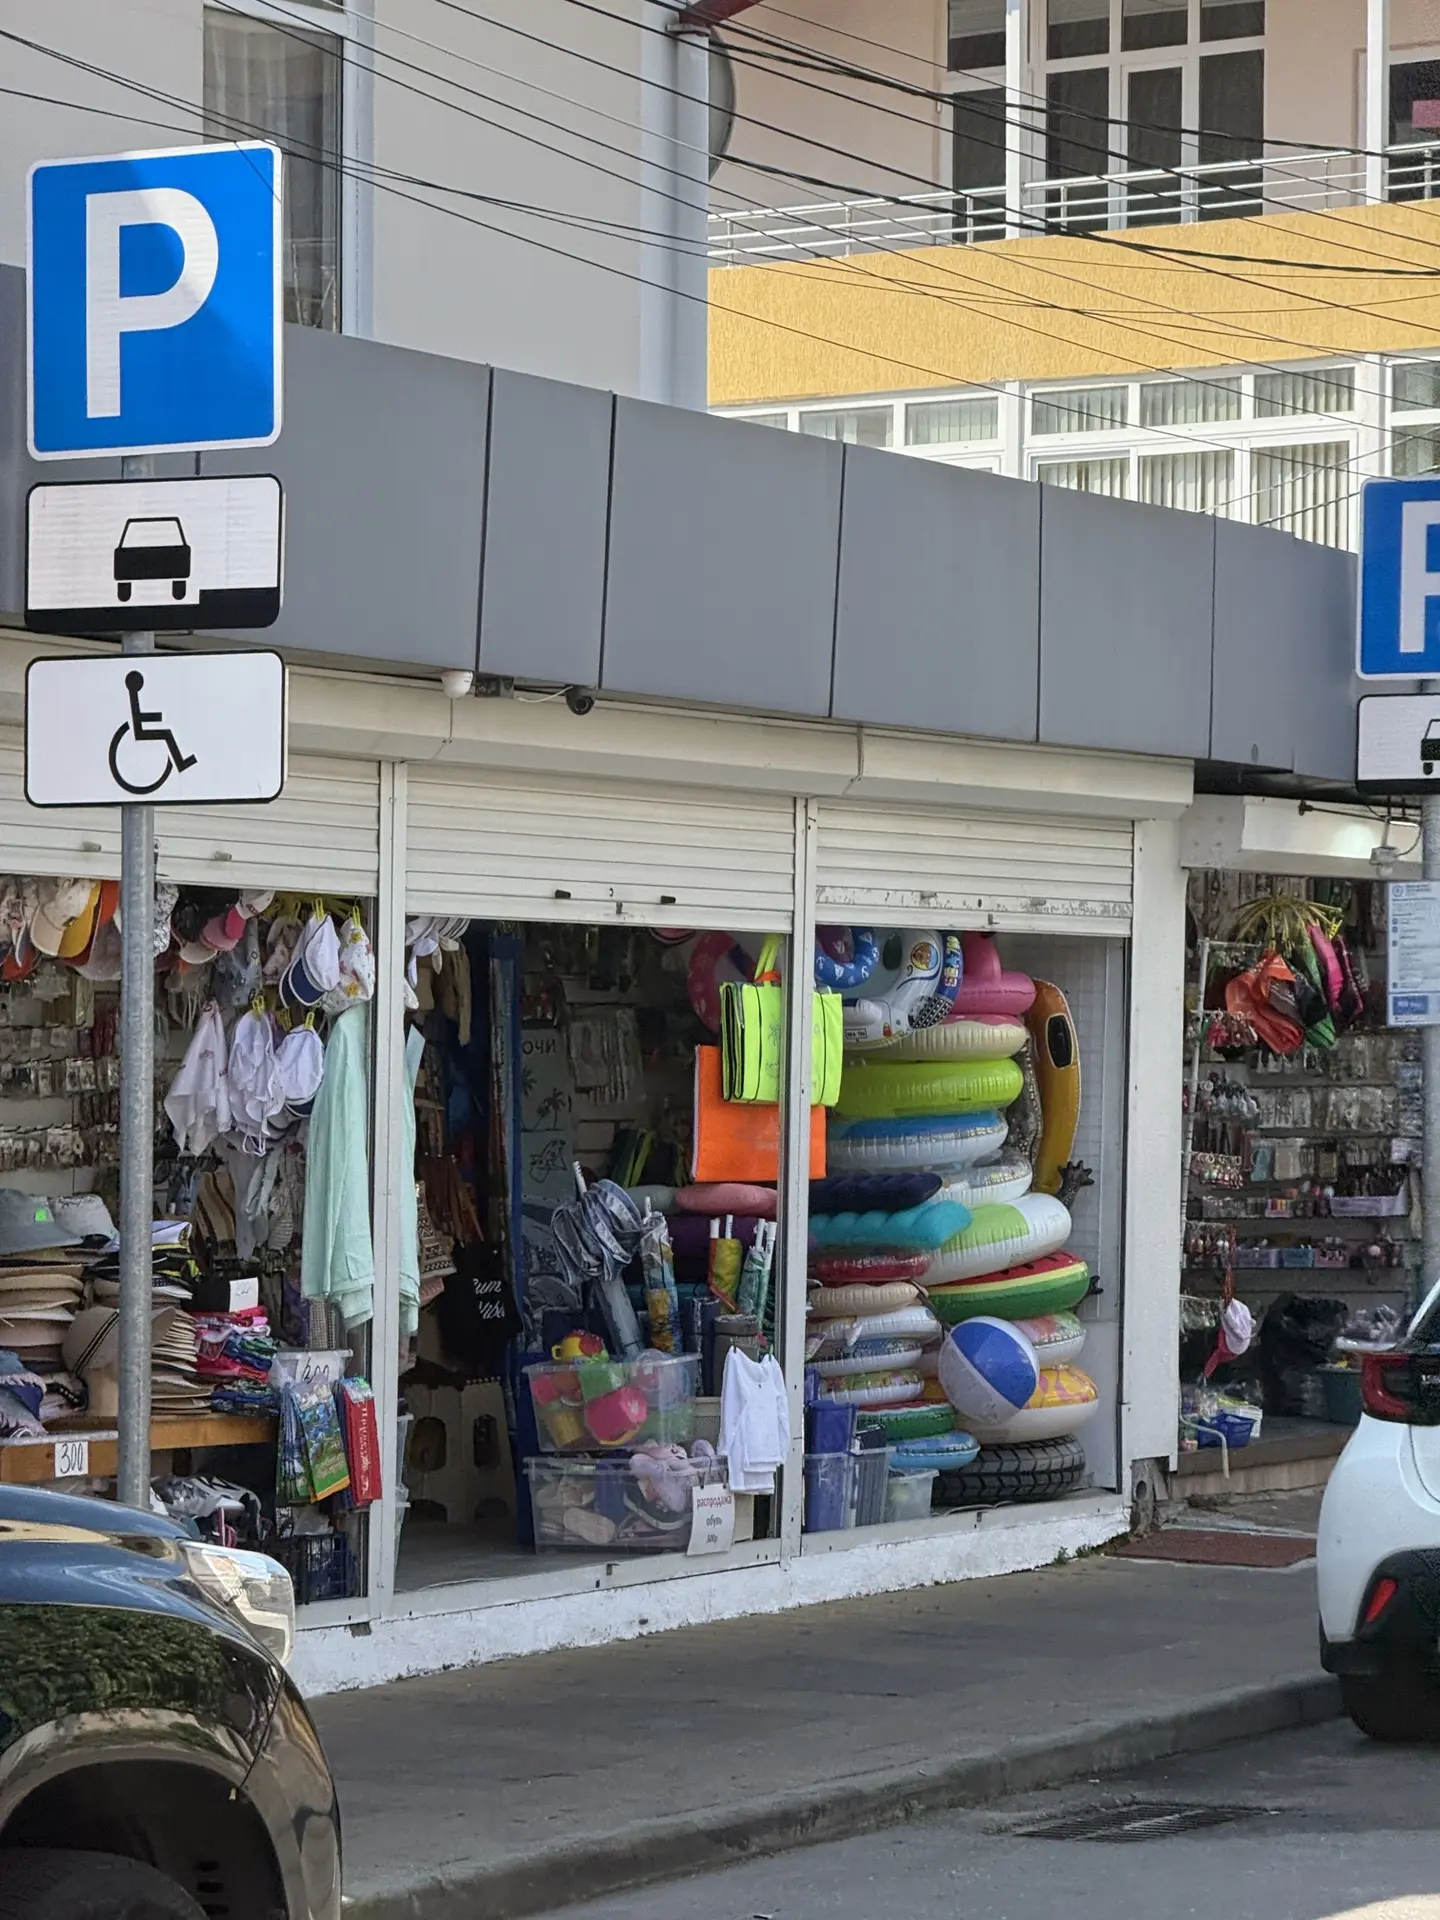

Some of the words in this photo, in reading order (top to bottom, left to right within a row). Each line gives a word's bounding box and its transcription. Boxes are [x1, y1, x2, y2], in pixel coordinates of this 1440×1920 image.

[86, 187, 220, 420] P
[522, 1038, 557, 1055] ОЧИ
[60, 1442, 84, 1475] 300
[696, 1495, 732, 1510] распродажа
